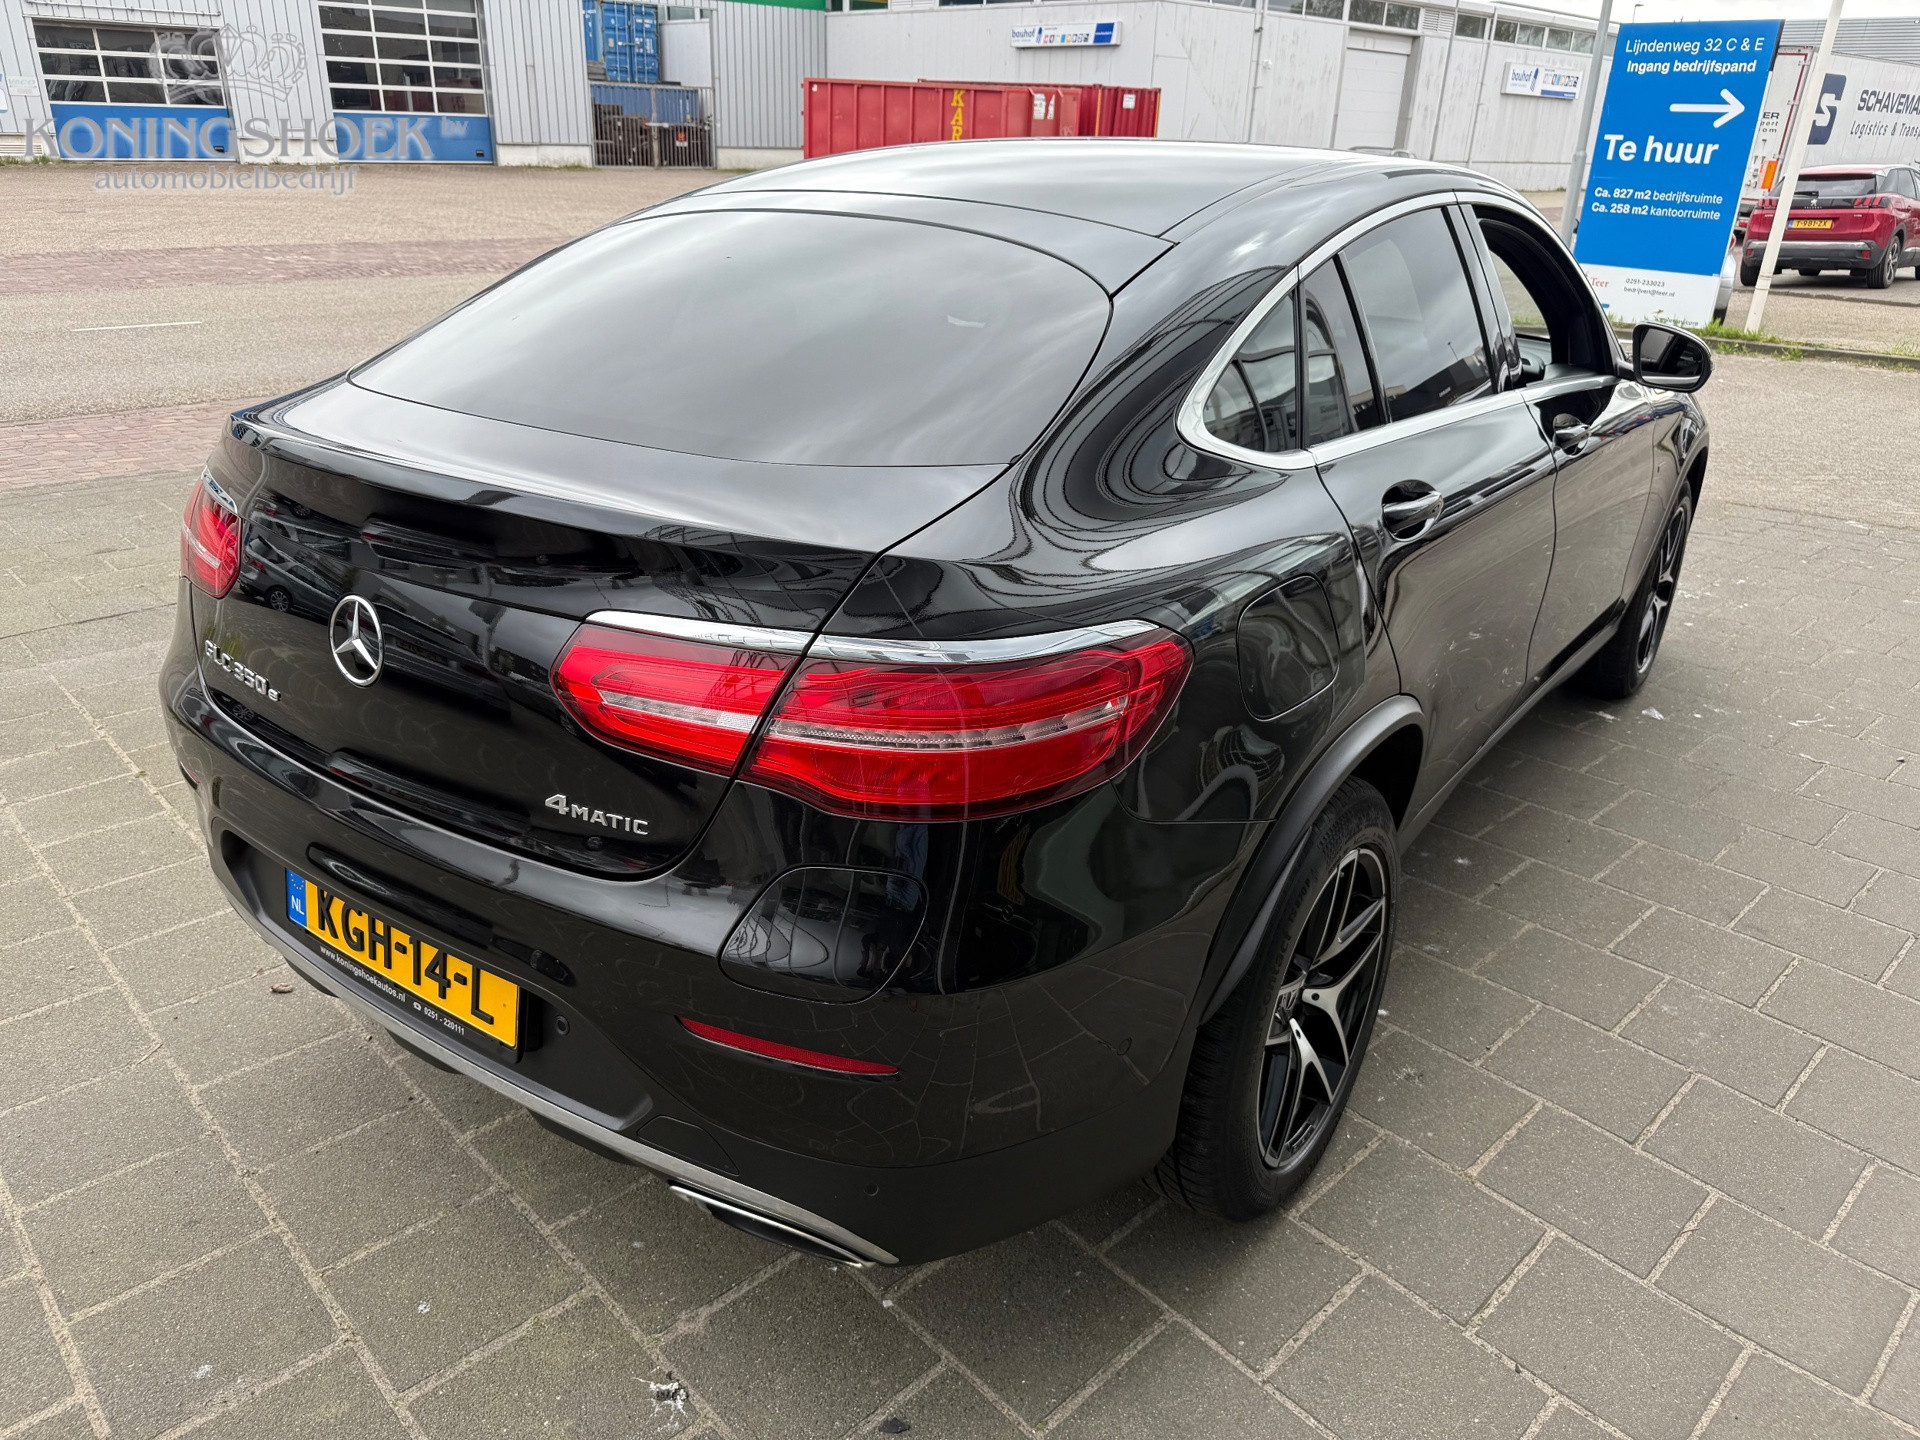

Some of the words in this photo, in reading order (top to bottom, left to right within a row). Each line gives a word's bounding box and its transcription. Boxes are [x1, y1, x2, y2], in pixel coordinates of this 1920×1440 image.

[1625, 39, 1700, 55] Lijndenweg
[1704, 38, 1723, 51] 32
[1726, 38, 1737, 51] C
[1740, 38, 1750, 51] &
[1754, 38, 1765, 51] E
[1627, 60, 1670, 75] Ingang
[1673, 59, 1757, 75] bedrijfspand
[1850, 121, 1889, 139] Logistics
[1604, 134, 1637, 161] Te
[1643, 135, 1719, 165] huur
[1594, 187, 1611, 198] Ca.
[1613, 188, 1634, 199] 827
[1634, 190, 1652, 200] m2
[1653, 190, 1723, 205] bedrijfsruimte
[1591, 202, 1608, 213] Ca.
[1610, 203, 1631, 215] 258
[1631, 205, 1649, 216] m2
[1650, 205, 1720, 220] kantoorruimte
[545, 794, 648, 835] 4MATIC
[291, 895, 305, 915] NL
[317, 888, 494, 1025] KGH-14-L
[320, 945, 406, 1002] www.koningshoekautos.nl
[424, 1006, 438, 1021] 0251
[443, 1019, 465, 1035] 220111
